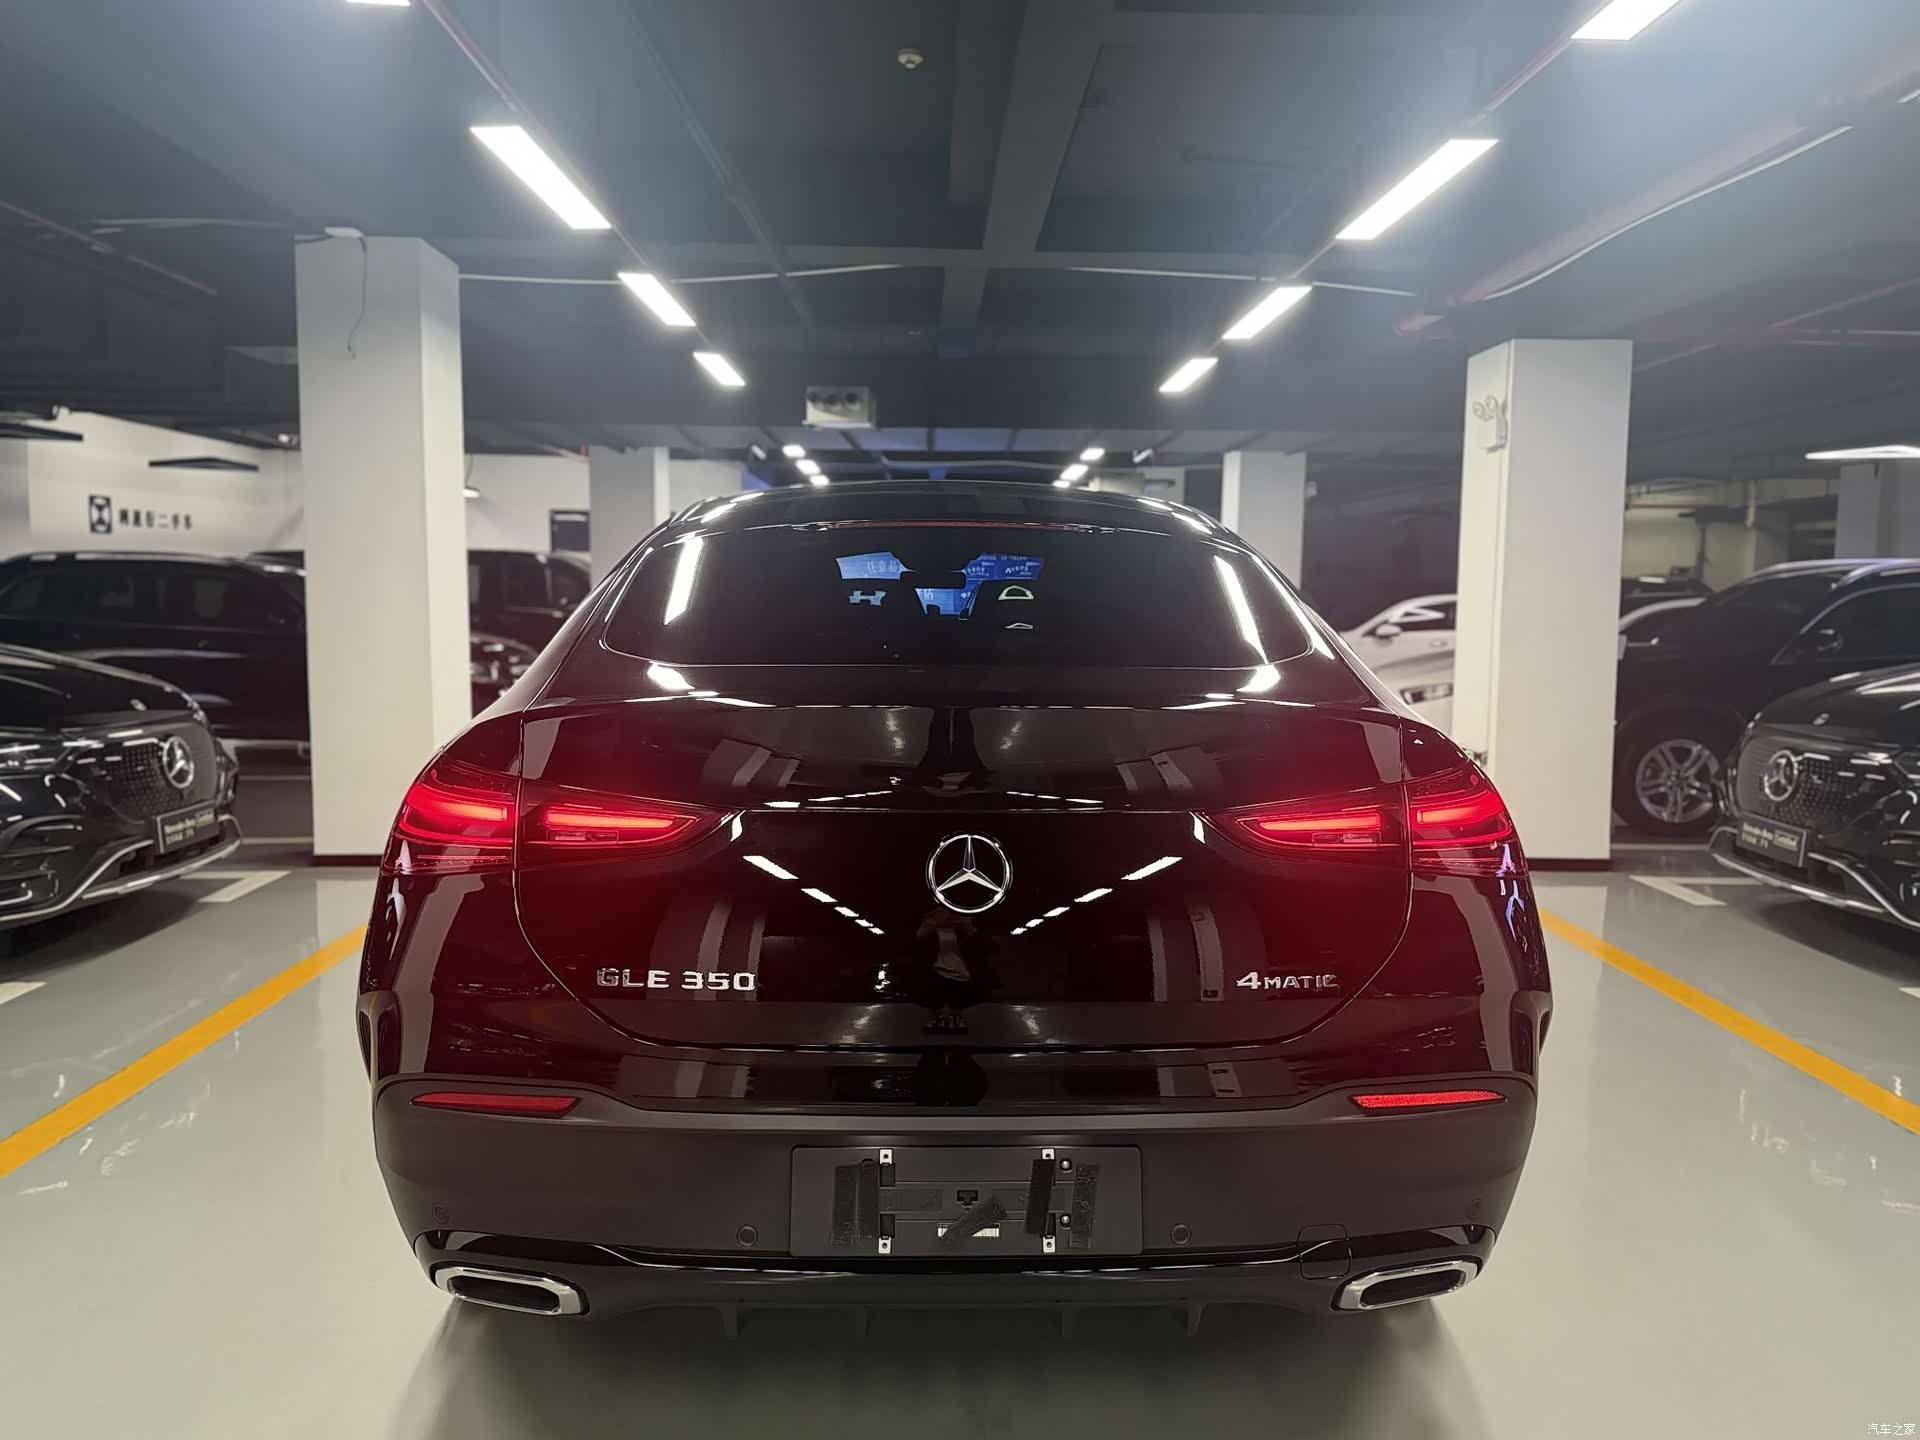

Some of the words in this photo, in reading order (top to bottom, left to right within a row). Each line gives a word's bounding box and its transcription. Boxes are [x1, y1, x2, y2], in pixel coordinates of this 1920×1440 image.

[596, 967, 670, 988] GLE
[681, 970, 756, 991] 350
[1236, 971, 1340, 990] 4MATIC
